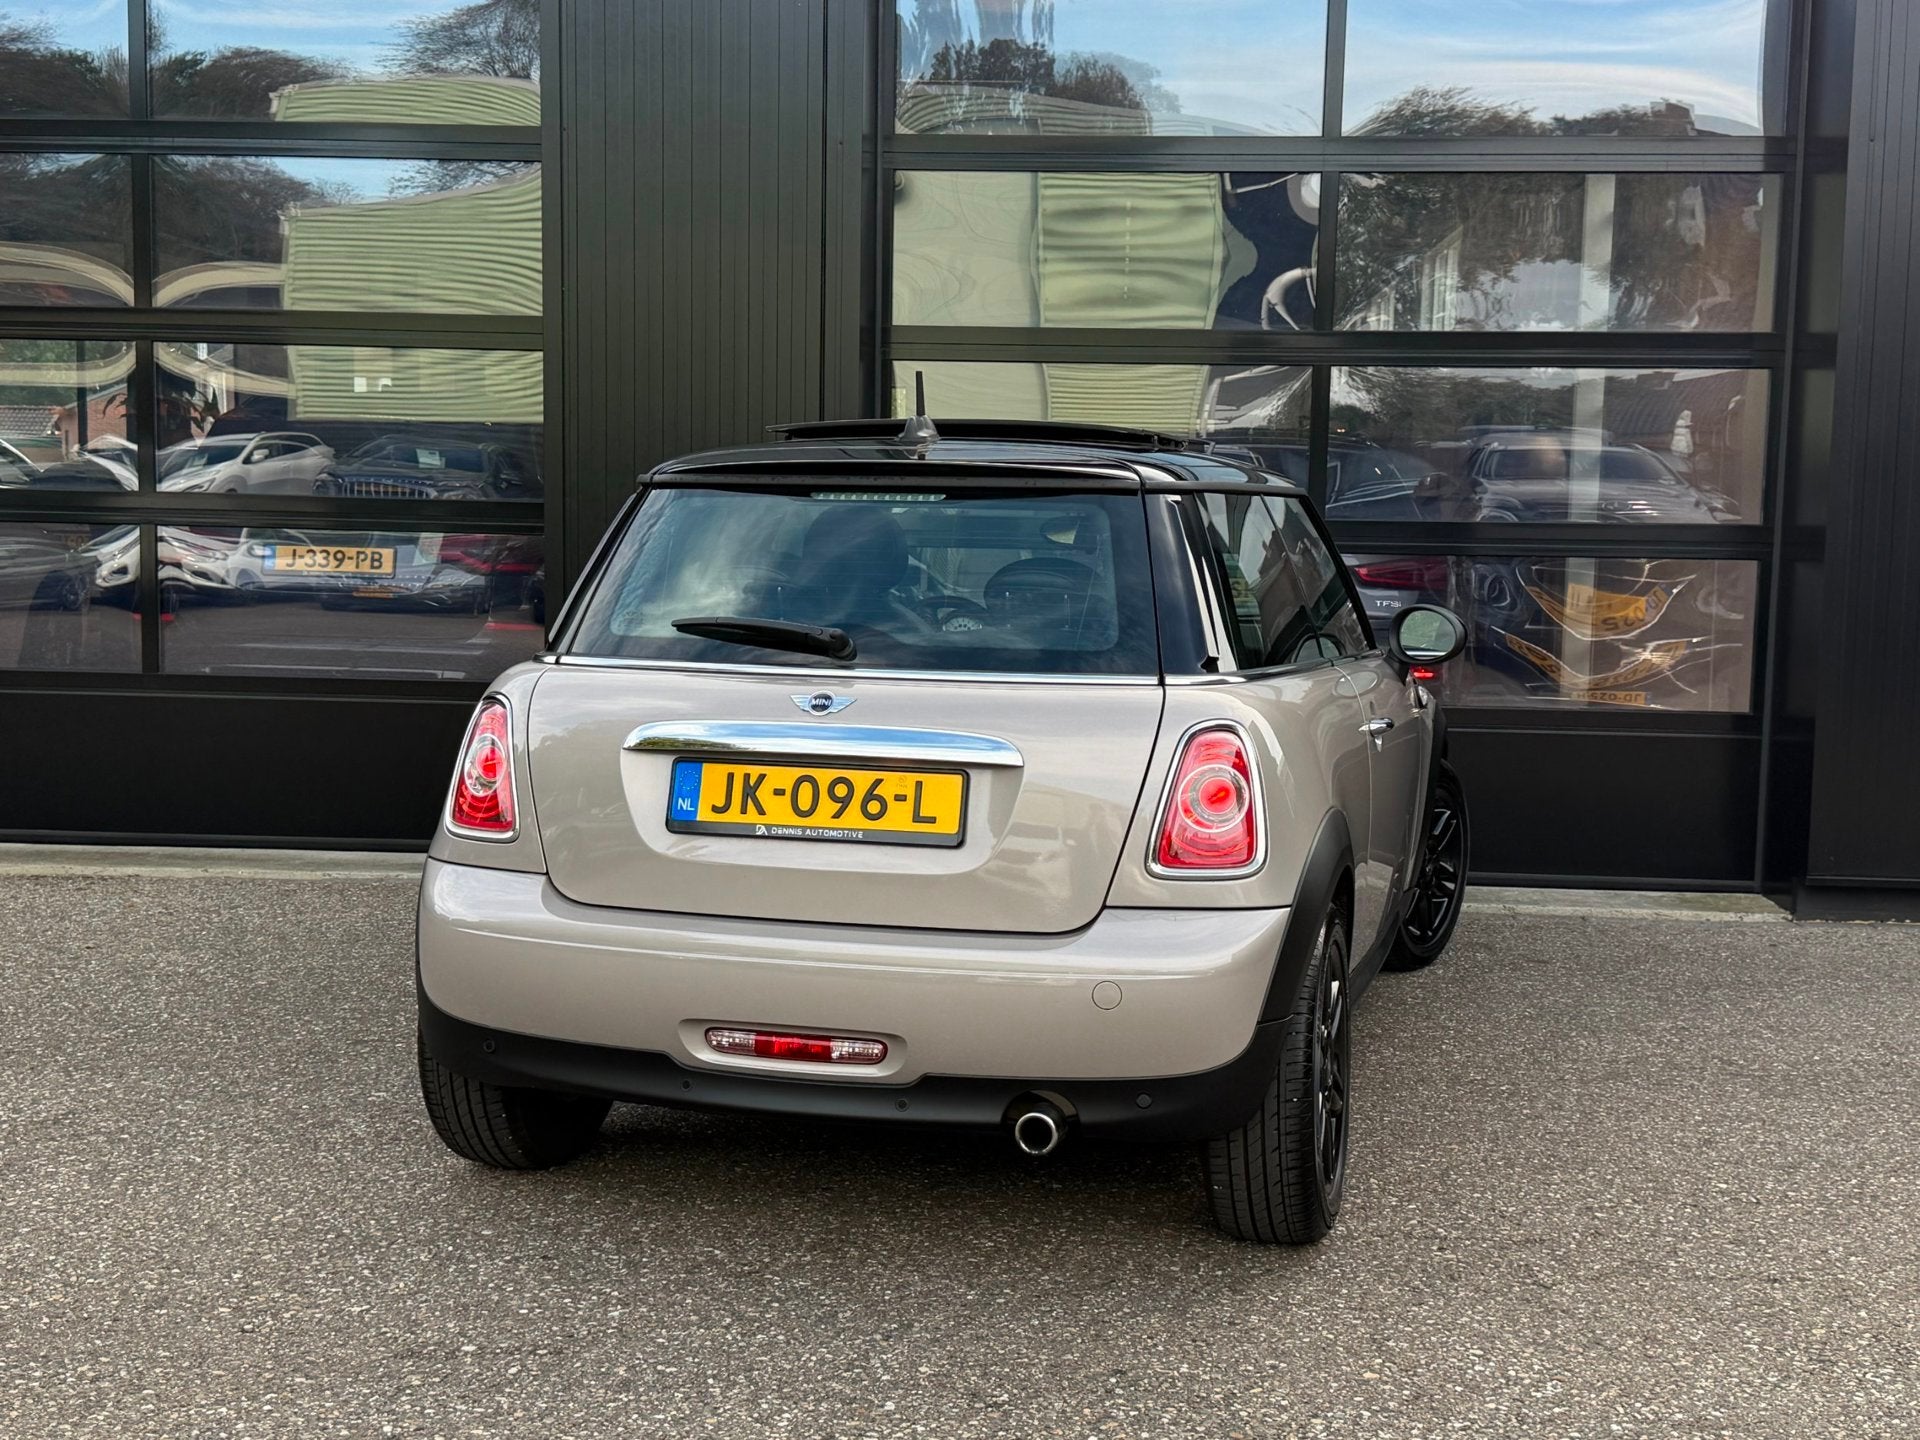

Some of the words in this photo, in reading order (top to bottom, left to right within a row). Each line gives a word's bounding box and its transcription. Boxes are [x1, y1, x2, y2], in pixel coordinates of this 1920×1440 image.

[286, 548, 383, 570] J-339-PB
[811, 698, 832, 706] MINI
[677, 798, 695, 811] NL
[711, 772, 937, 824] JK-096-L
[771, 826, 803, 836] DENNIS
[805, 828, 864, 839] AUTOMOTIVE
